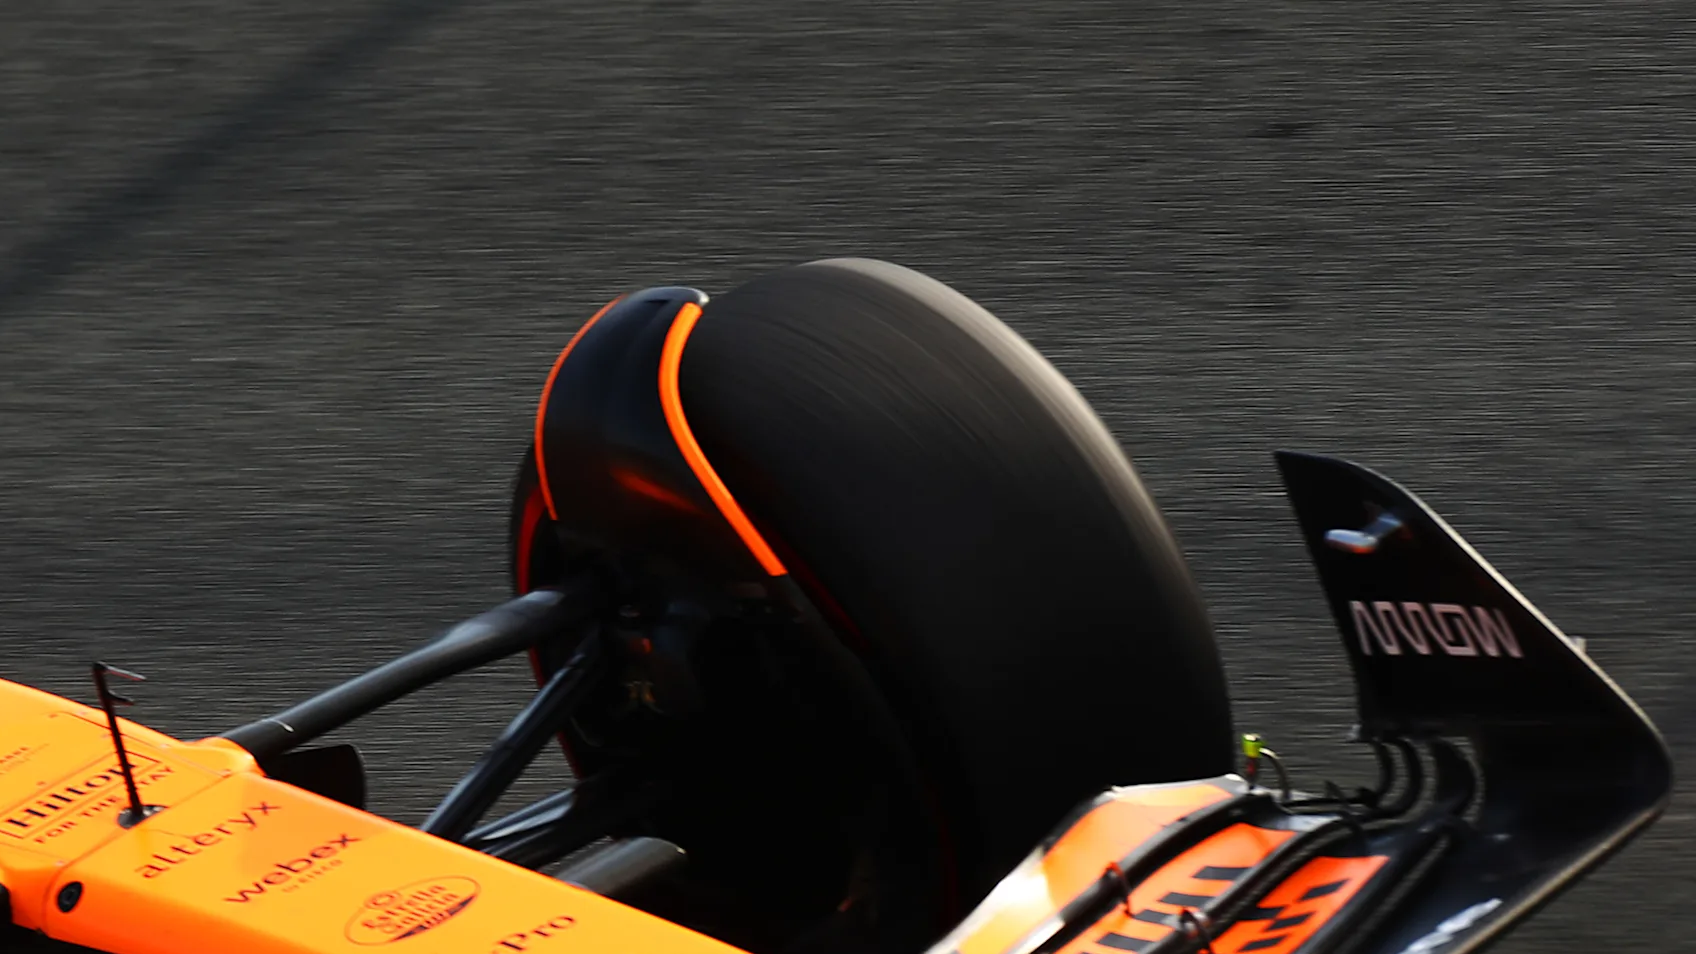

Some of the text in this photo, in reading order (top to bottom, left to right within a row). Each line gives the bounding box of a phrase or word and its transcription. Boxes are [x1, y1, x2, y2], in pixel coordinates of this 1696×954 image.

[5, 762, 156, 828] Hilton
[134, 801, 282, 879] alteryx
[220, 833, 362, 904] webex
